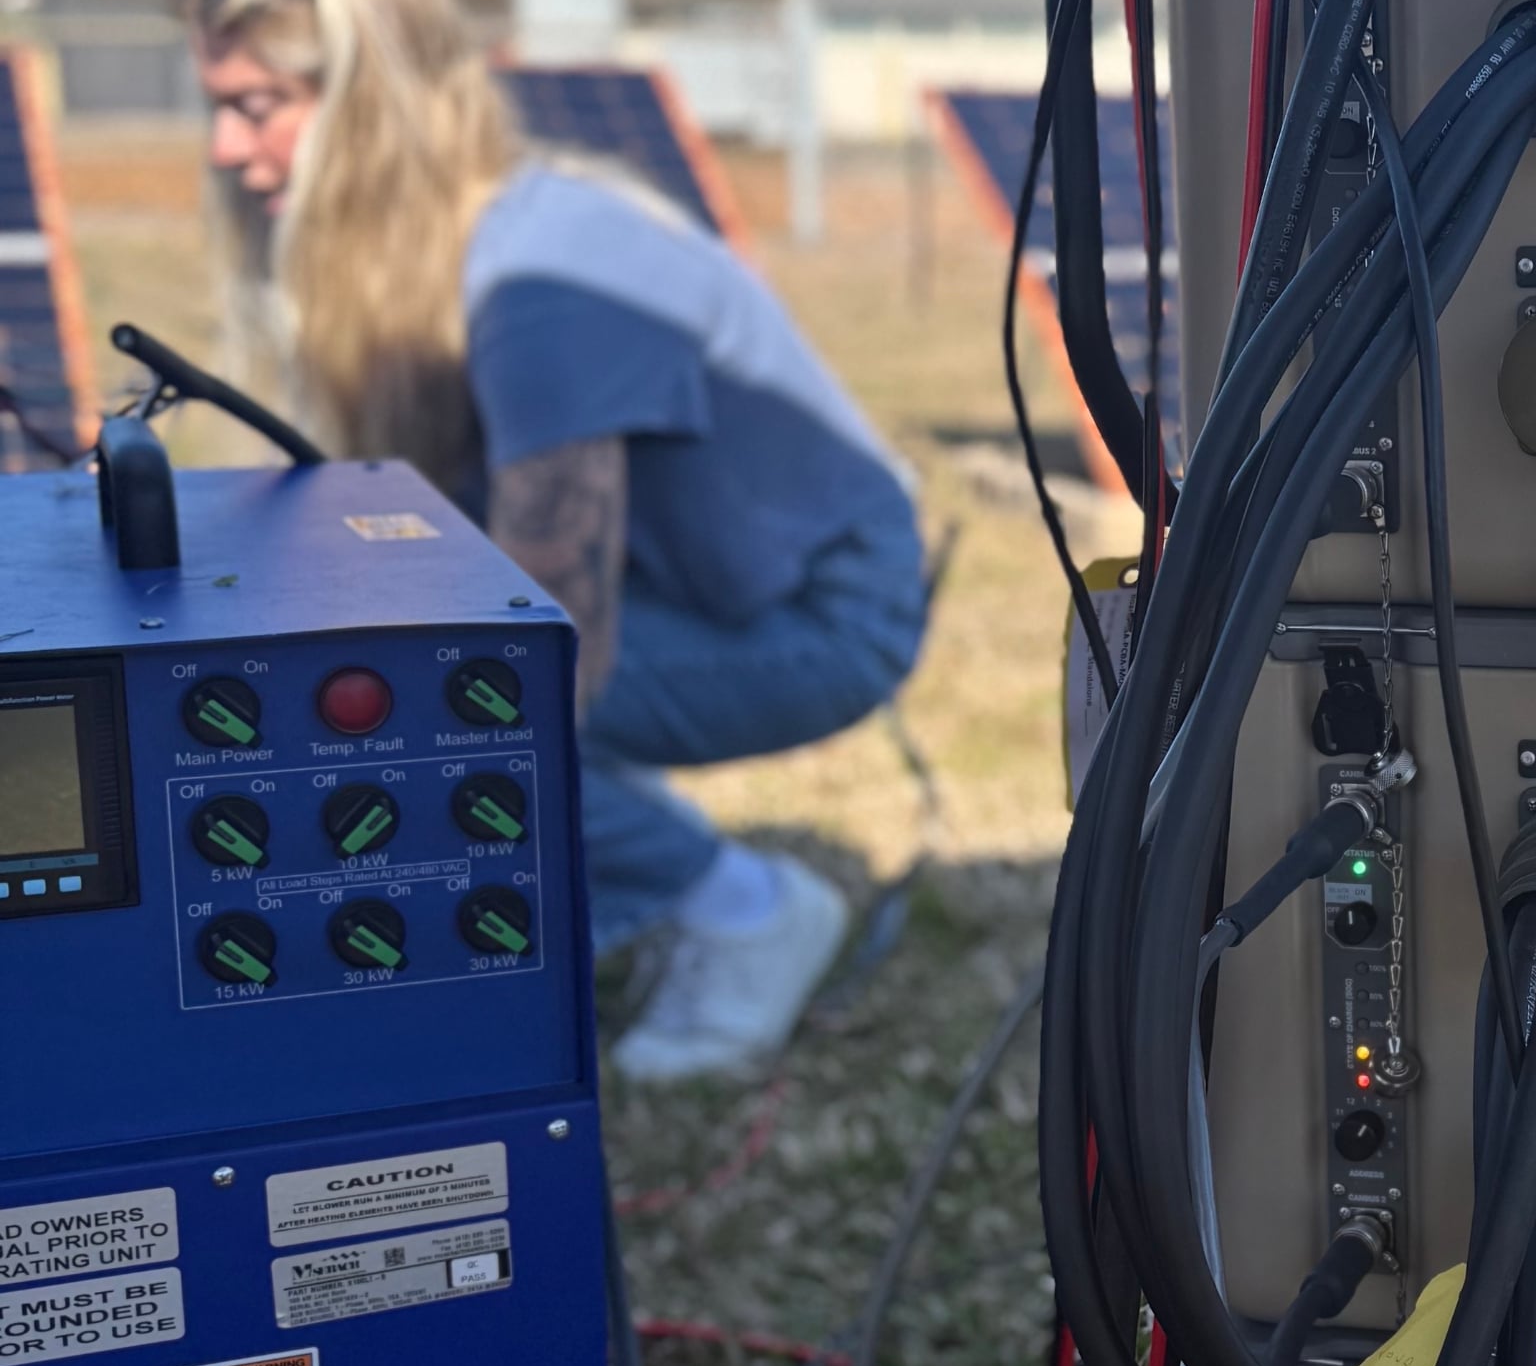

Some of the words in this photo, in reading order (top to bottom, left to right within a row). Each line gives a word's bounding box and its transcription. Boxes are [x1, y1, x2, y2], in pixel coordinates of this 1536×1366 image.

[437, 648, 460, 661] Off
[504, 644, 527, 657] On
[172, 664, 197, 678] Off
[244, 660, 269, 674] On
[436, 732, 489, 747] Master
[494, 728, 533, 743] Load
[175, 751, 216, 766] Main
[221, 747, 274, 763] Power
[310, 742, 358, 757] Temp.
[364, 738, 404, 752] Fault
[442, 764, 465, 777] Off
[509, 759, 532, 772] On
[313, 774, 337, 788] Off
[382, 769, 406, 782] On
[180, 785, 205, 798] Off
[250, 779, 276, 793] On
[466, 844, 484, 857] 10
[487, 842, 514, 856] kW
[362, 853, 389, 867] kW
[211, 869, 222, 882] 5
[227, 866, 254, 881] kW
[262, 880, 279, 891] All
[281, 877, 307, 889] Load
[310, 873, 342, 889] Steps
[344, 870, 376, 883] Rated
[379, 869, 392, 881] At
[442, 861, 467, 875] VAC
[447, 877, 470, 891] Off
[513, 871, 536, 884] On
[319, 890, 343, 904] Off
[387, 884, 411, 897] On
[188, 902, 212, 917] Off
[258, 896, 282, 910] On
[469, 957, 488, 971] 30
[493, 953, 519, 968] kW
[344, 971, 363, 985] 30
[368, 967, 394, 982] kW
[215, 986, 234, 999] 15
[239, 983, 265, 998] kW
[326, 1162, 454, 1191] CAUTION
[293, 1205, 310, 1214] LET
[312, 1199, 351, 1212] BLOWER
[353, 1196, 373, 1205] RUN
[375, 1195, 382, 1203] A
[384, 1187, 426, 1201] MINIMUM
[429, 1185, 440, 1194] OF
[450, 1177, 490, 1190] MINUTES
[277, 1218, 306, 1229] AFTER
[308, 1212, 346, 1225] HEATING
[348, 1205, 394, 1218] ELEMENTS
[395, 1200, 419, 1211] HAVE
[421, 1197, 444, 1207] BEEN
[445, 1189, 494, 1203] SHUTDOWN
[31, 1207, 144, 1235] OWNERS
[48, 1228, 127, 1252] PRIOR
[134, 1223, 168, 1240] TO
[100, 1243, 156, 1265] UNIT
[461, 1272, 487, 1283] PASS
[21, 1290, 114, 1316] MUST
[125, 1281, 168, 1300] BE
[0, 1301, 158, 1337] OUNDED
[55, 1330, 100, 1347] TO
[112, 1317, 177, 1338] USE
